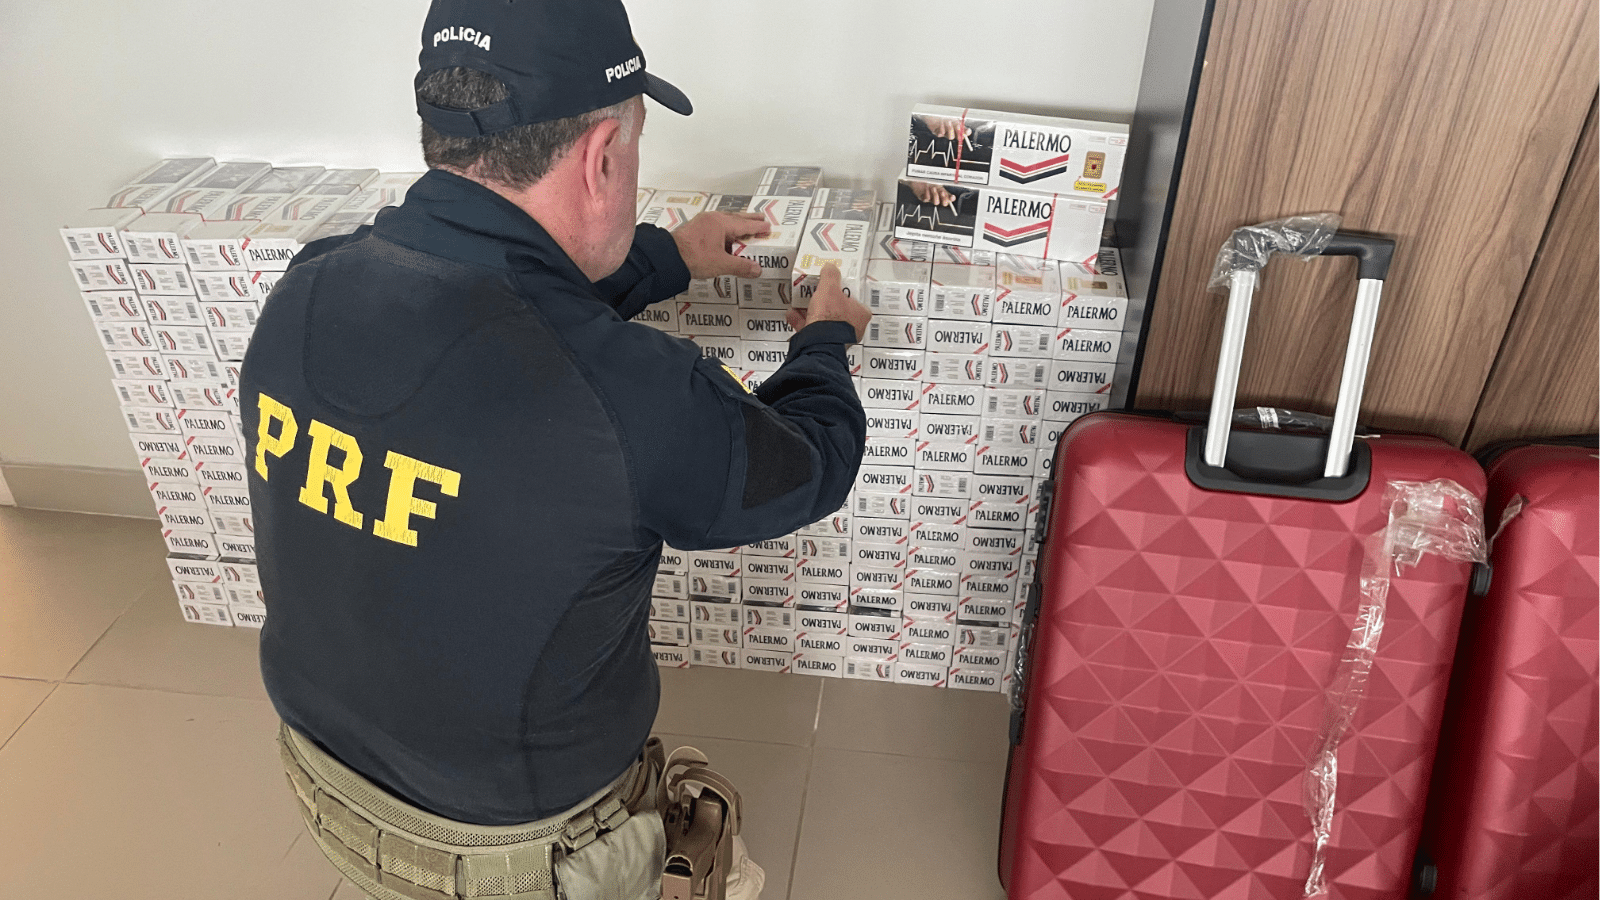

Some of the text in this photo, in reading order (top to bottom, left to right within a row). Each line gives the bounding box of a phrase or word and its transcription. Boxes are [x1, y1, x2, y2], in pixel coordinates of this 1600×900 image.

[1003, 128, 1072, 153] PALERMO
[781, 199, 806, 226] PALERMO
[986, 195, 1052, 219] PALERMO
[840, 223, 864, 253] PALERMO
[248, 248, 294, 261] PALERMO
[1099, 249, 1119, 276] PALERMO
[1002, 300, 1052, 316] PALERMO
[1067, 305, 1118, 320] PALERMO
[685, 313, 733, 327] PALERMO
[934, 330, 983, 344] PALERMO
[1061, 338, 1112, 353] PALERMO
[700, 346, 735, 359] LERMO
[869, 357, 917, 370] PALERMO
[1057, 370, 1107, 384] PALERMO
[868, 388, 914, 400] PALERMO
[928, 393, 975, 405] PALERMO
[184, 418, 226, 430] PALERMO
[867, 417, 912, 429] PALERMO
[927, 424, 973, 435] PALERMO
[138, 441, 180, 452] PALERMO
[193, 444, 234, 456] PALERMO
[922, 450, 967, 463] PALERMO
[982, 454, 1028, 467] PALERMO
[148, 465, 189, 477] PALERMO
[201, 470, 243, 481] PALERMO
[255, 392, 461, 547] PRF
[863, 473, 907, 485] PALERMO
[156, 490, 197, 501] PALERMO
[978, 484, 1024, 495] PALERMO
[209, 494, 249, 506] PALERMO
[917, 504, 962, 516] PALERMO
[975, 509, 1020, 521] PALERMO
[165, 513, 205, 525] PALERMO
[860, 525, 902, 537] PALERMO
[916, 530, 959, 542] PALERMO
[170, 536, 209, 549] PALERMO
[972, 536, 1017, 548] PALERMO
[859, 549, 901, 560] PALERMO
[914, 553, 956, 565] PALERMO
[694, 558, 735, 570] PALERMO
[748, 563, 789, 574] PALERMO
[969, 559, 1013, 571] PALERMO
[175, 566, 214, 576] PALERMO
[801, 566, 843, 578] PALERMO
[856, 572, 898, 583] PALERMO
[910, 577, 953, 589] PALERMO
[748, 585, 789, 596] PALERMO
[966, 581, 1009, 593] PALERMO
[801, 590, 842, 600] PALERMO
[856, 594, 897, 605] PALERMO
[910, 601, 952, 612] PALERMO
[964, 604, 1006, 616] PALERMO
[801, 617, 842, 628] PALERMO
[855, 622, 895, 633] PALERMO
[908, 627, 950, 639] PALERMO
[748, 634, 788, 645] PALERMO
[800, 638, 841, 650] PALERMO
[853, 643, 893, 654] PALERMO
[905, 648, 946, 661] PALERMO
[746, 655, 786, 666] PALERMO
[797, 659, 837, 671] PALERMO
[958, 654, 1000, 666] PALERMO
[900, 669, 940, 681] PALERMO
[954, 674, 995, 686] PALERMO
